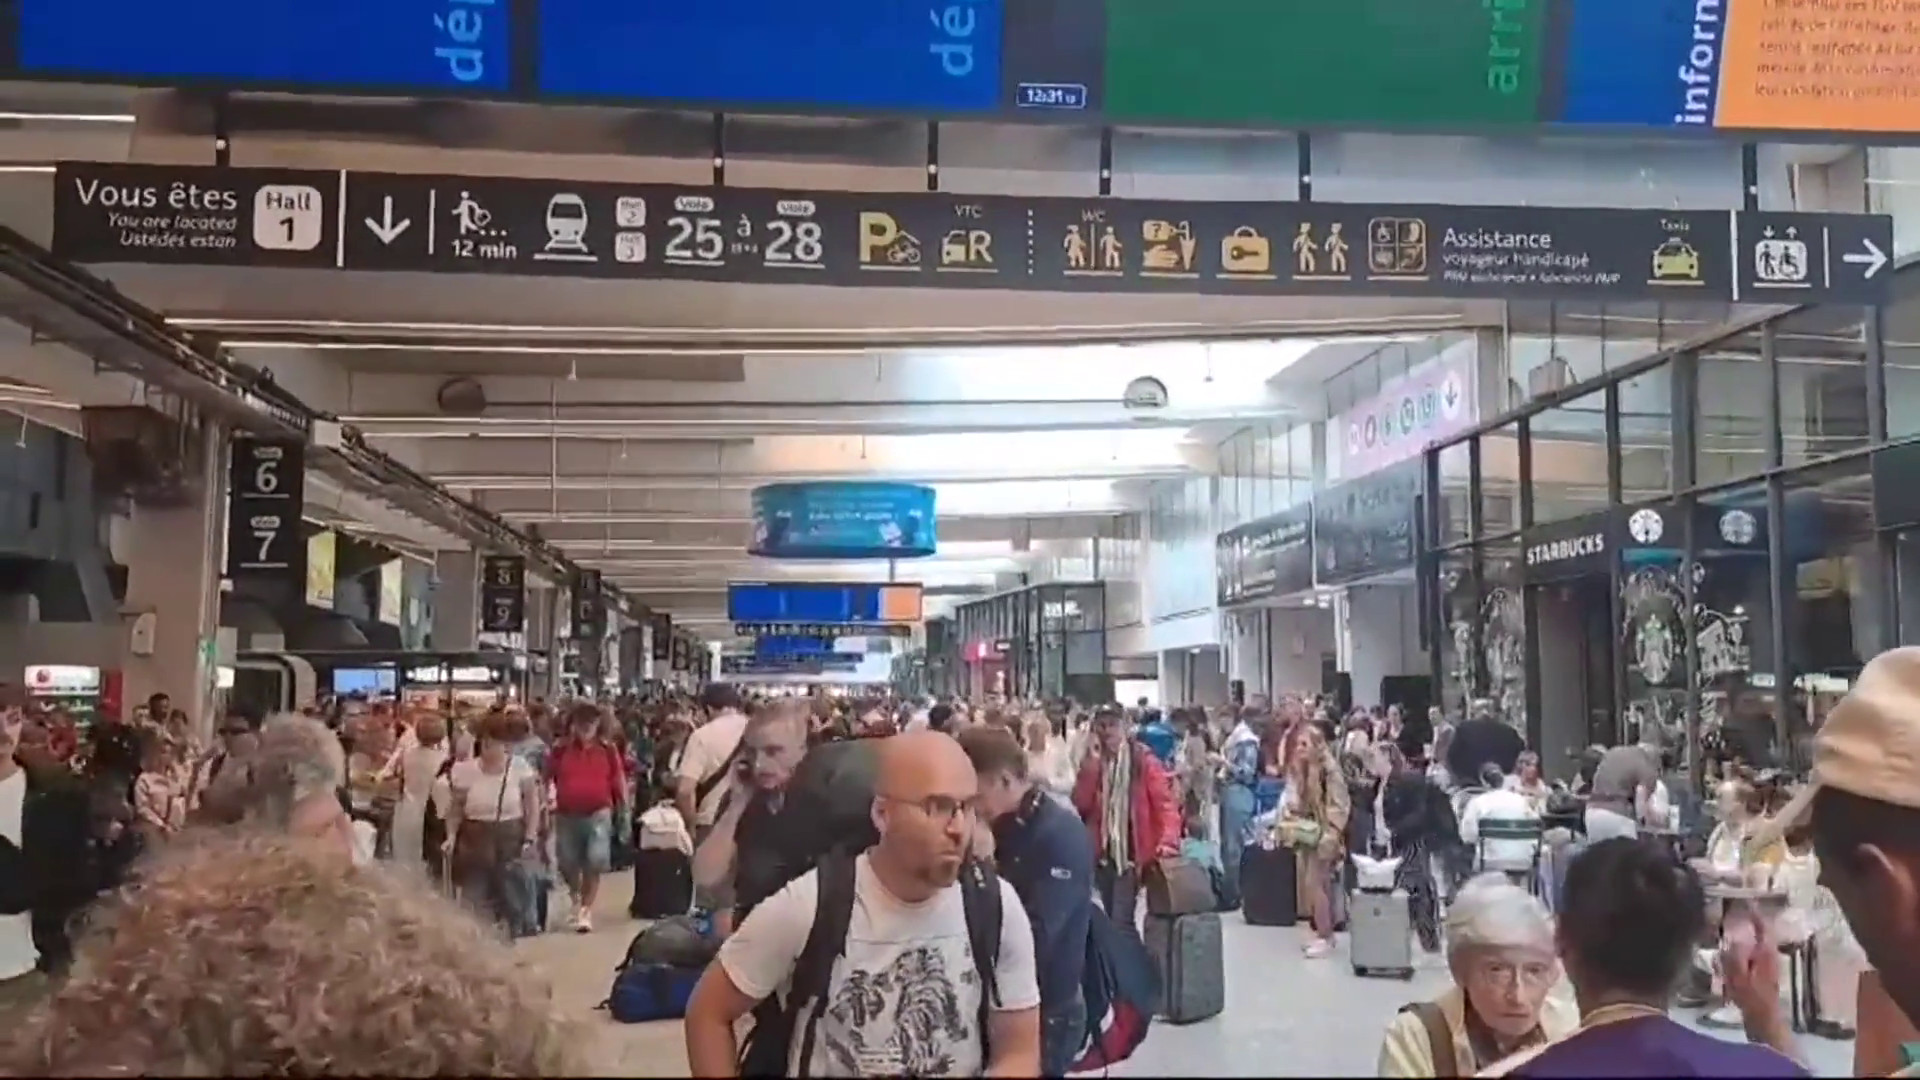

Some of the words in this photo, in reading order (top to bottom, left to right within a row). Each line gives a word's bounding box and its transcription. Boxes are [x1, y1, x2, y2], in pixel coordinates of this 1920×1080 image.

[434, 0, 495, 81] dé
[75, 177, 157, 207] Vous
[168, 181, 237, 211] êtes
[266, 191, 311, 212] Hall
[108, 211, 139, 227] You
[142, 214, 171, 229] are
[174, 215, 237, 231] located
[955, 204, 982, 219] VTC
[1082, 208, 1106, 222] WC
[279, 217, 294, 242] 1
[665, 216, 724, 260] 25
[737, 214, 752, 236] à
[765, 220, 823, 263] 28
[1443, 227, 1551, 248] Assistance
[452, 239, 474, 257] 12
[479, 241, 517, 258] min
[1443, 252, 1510, 269] voyageur
[256, 461, 278, 492] 6
[253, 530, 276, 561] 7
[1526, 533, 1604, 566] STARBUCKS
[497, 606, 510, 623] 9
